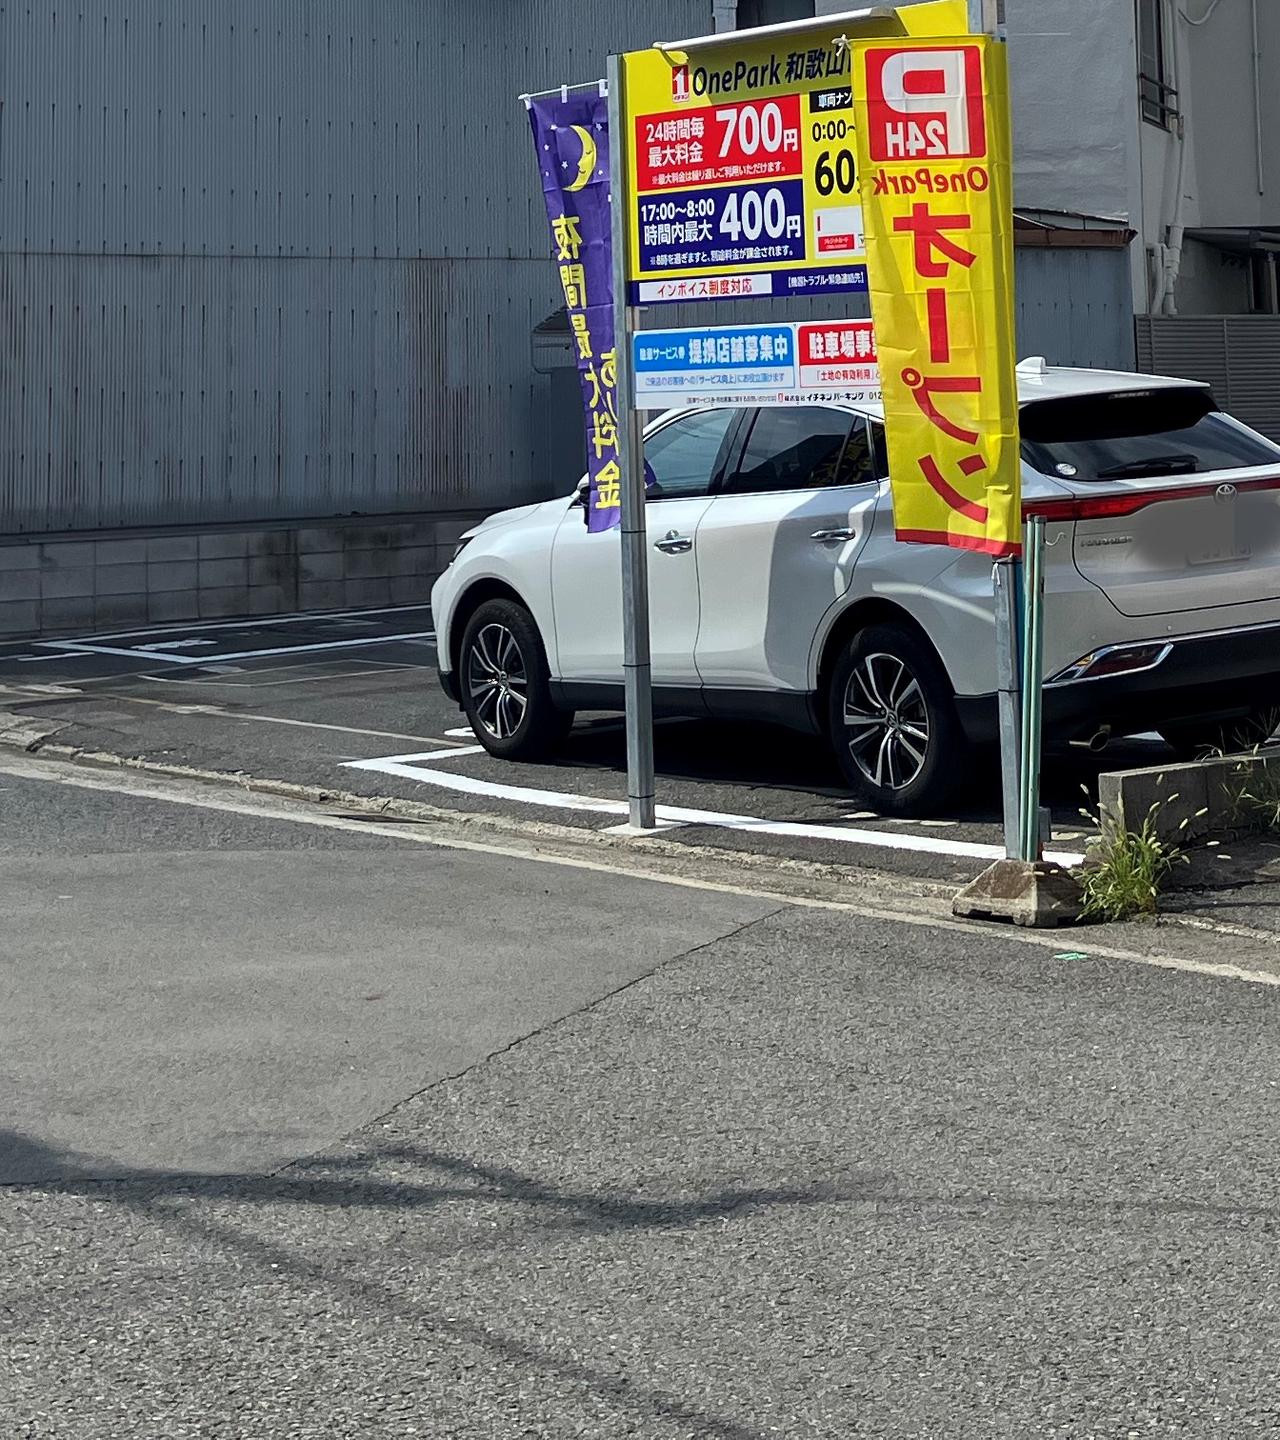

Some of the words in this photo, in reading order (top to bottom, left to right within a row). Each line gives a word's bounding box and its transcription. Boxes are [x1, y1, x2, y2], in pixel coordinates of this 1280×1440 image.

[692, 54, 781, 96] OnePark
[785, 47, 851, 82] 和歌山
[646, 116, 705, 143] 24時間毎
[716, 102, 799, 159] 700円
[648, 141, 703, 168] 最大料金
[814, 148, 861, 197] 60
[720, 188, 801, 242] 400円
[644, 218, 713, 246] 時間内最大
[657, 278, 752, 297] インボイス制度対応
[688, 333, 788, 364] 提携店舗募集中
[808, 329, 878, 359] 駐車場事
